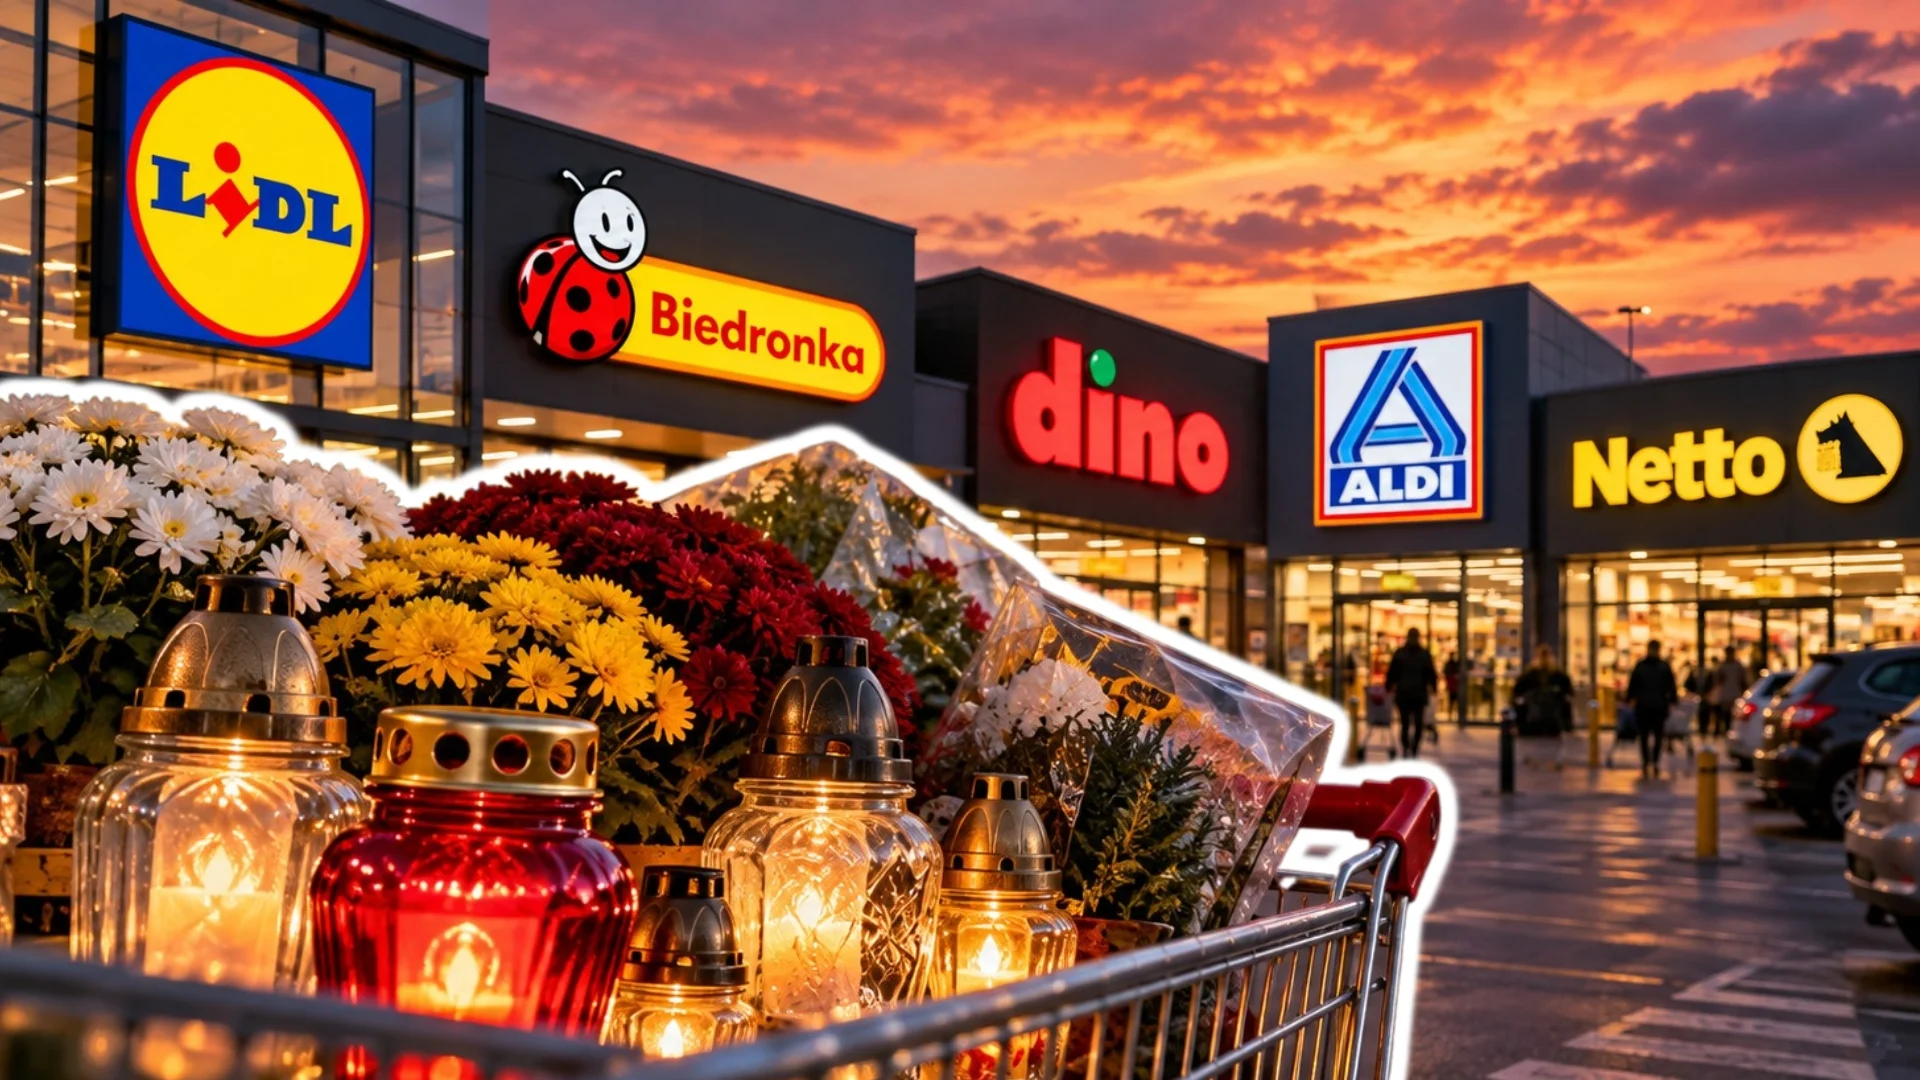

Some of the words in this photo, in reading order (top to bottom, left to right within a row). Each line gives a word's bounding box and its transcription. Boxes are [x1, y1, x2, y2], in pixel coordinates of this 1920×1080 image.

[650, 291, 865, 375] Biedronka
[1011, 337, 1229, 494] dino
[1339, 464, 1455, 504] ALDI
[1573, 429, 1785, 508] Netto
